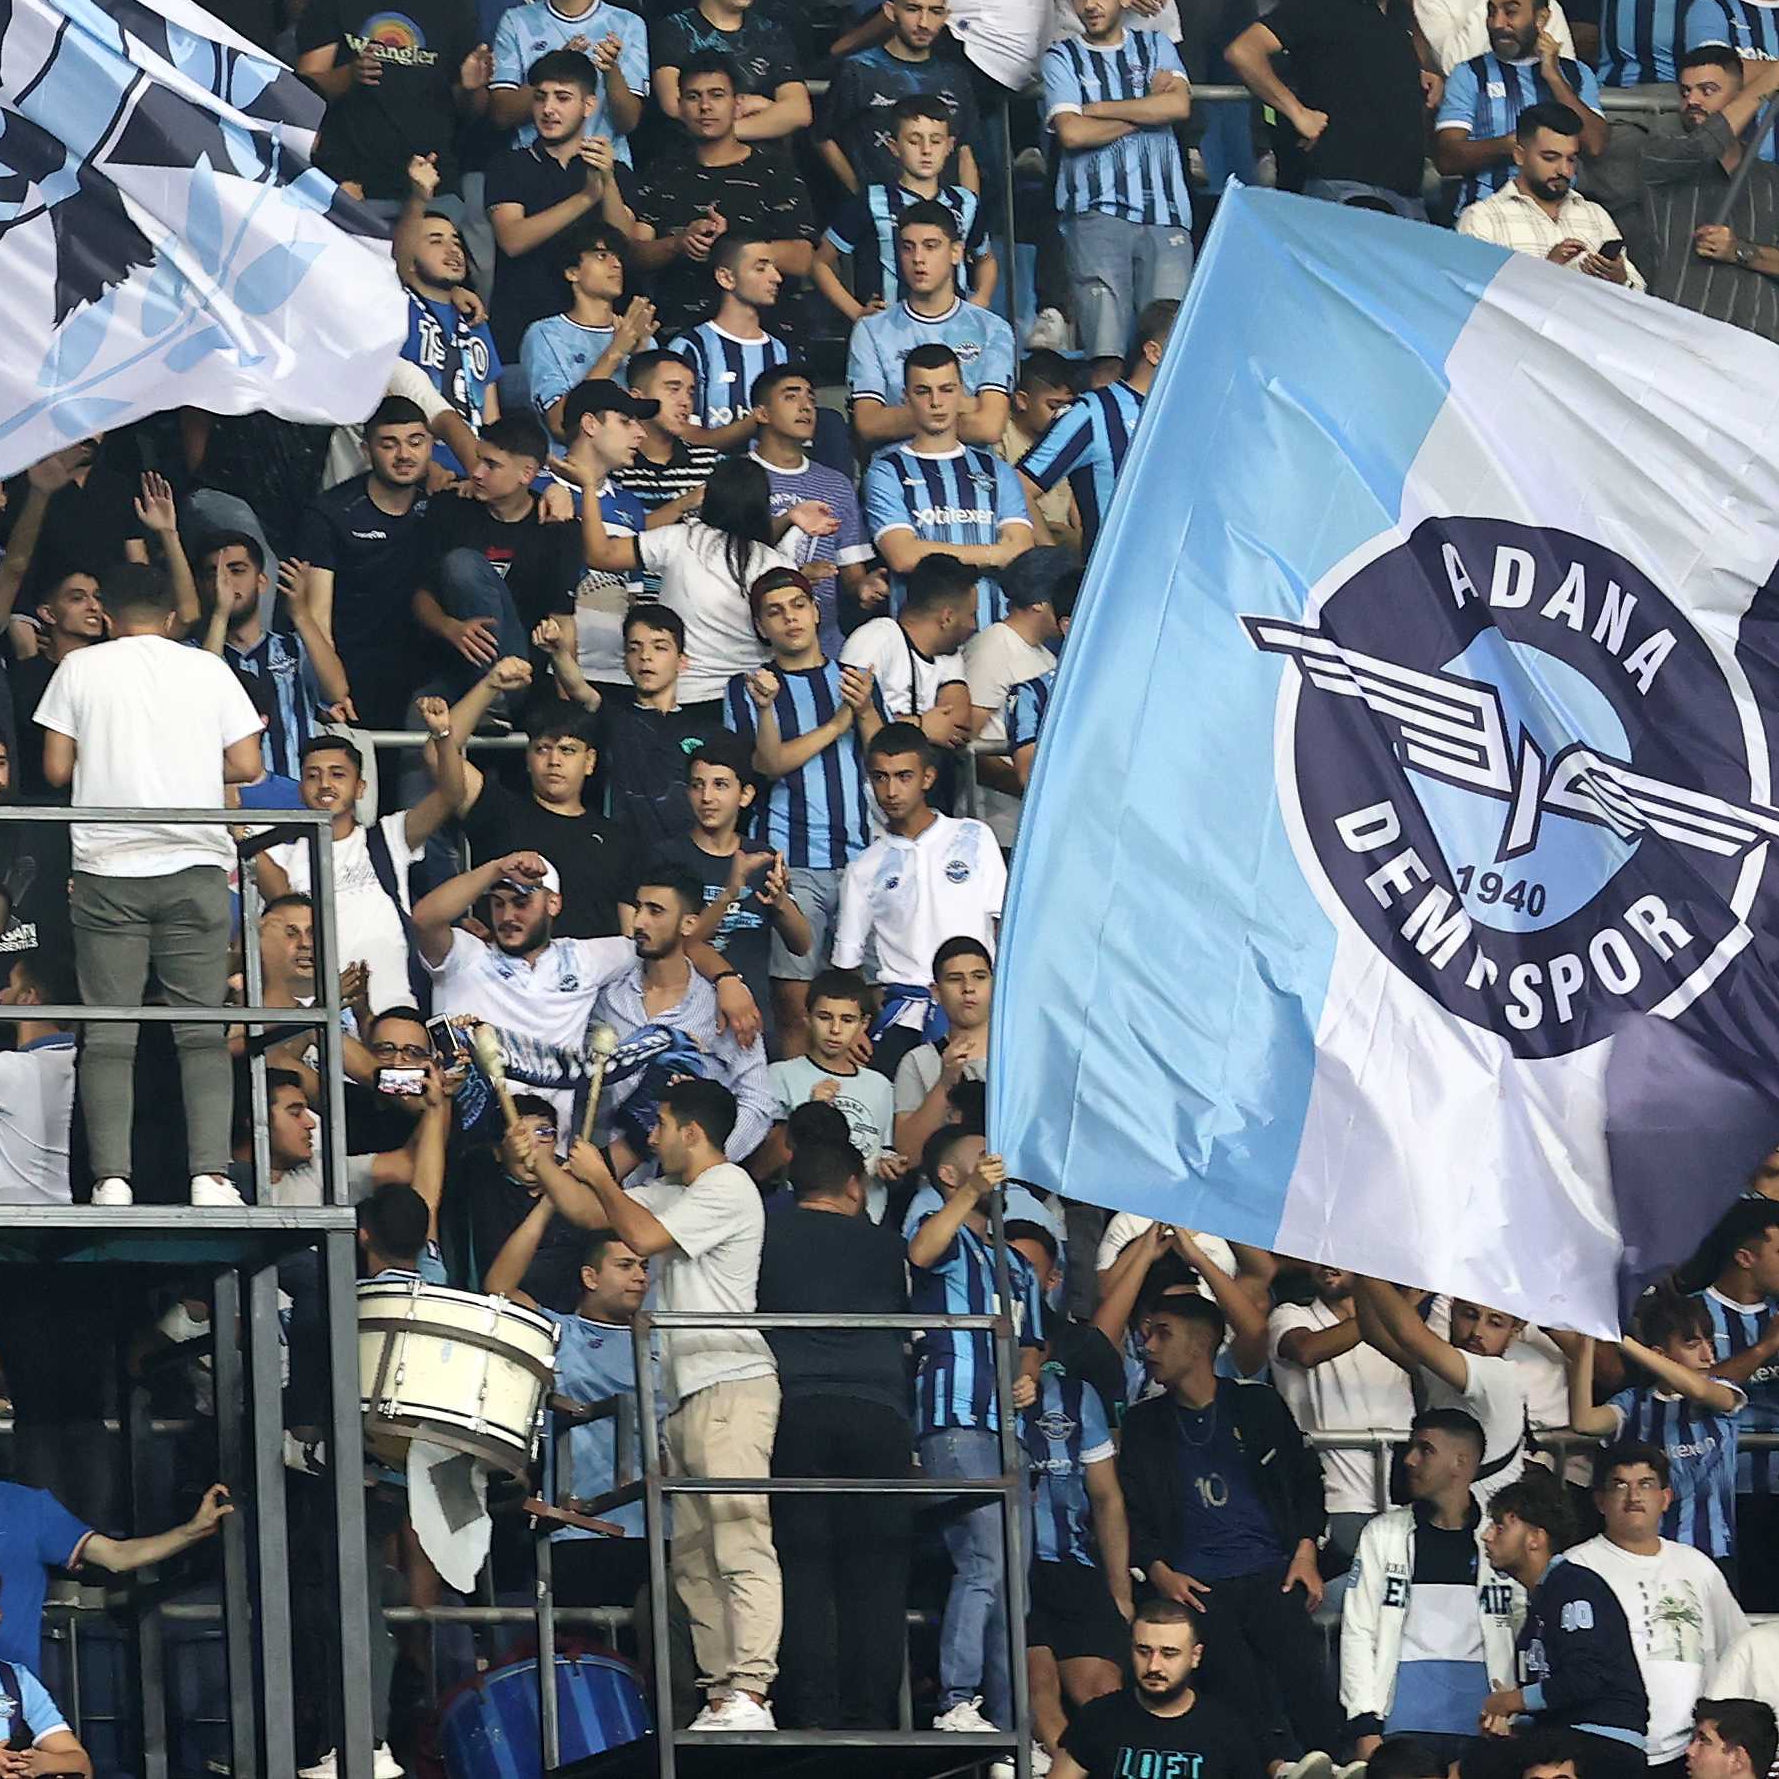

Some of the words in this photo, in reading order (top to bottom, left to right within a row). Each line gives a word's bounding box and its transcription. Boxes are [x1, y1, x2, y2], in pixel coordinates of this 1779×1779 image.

[1442, 542, 1678, 696] ADANA
[1454, 864, 1547, 918] 1940
[1194, 1472, 1229, 1509] 10
